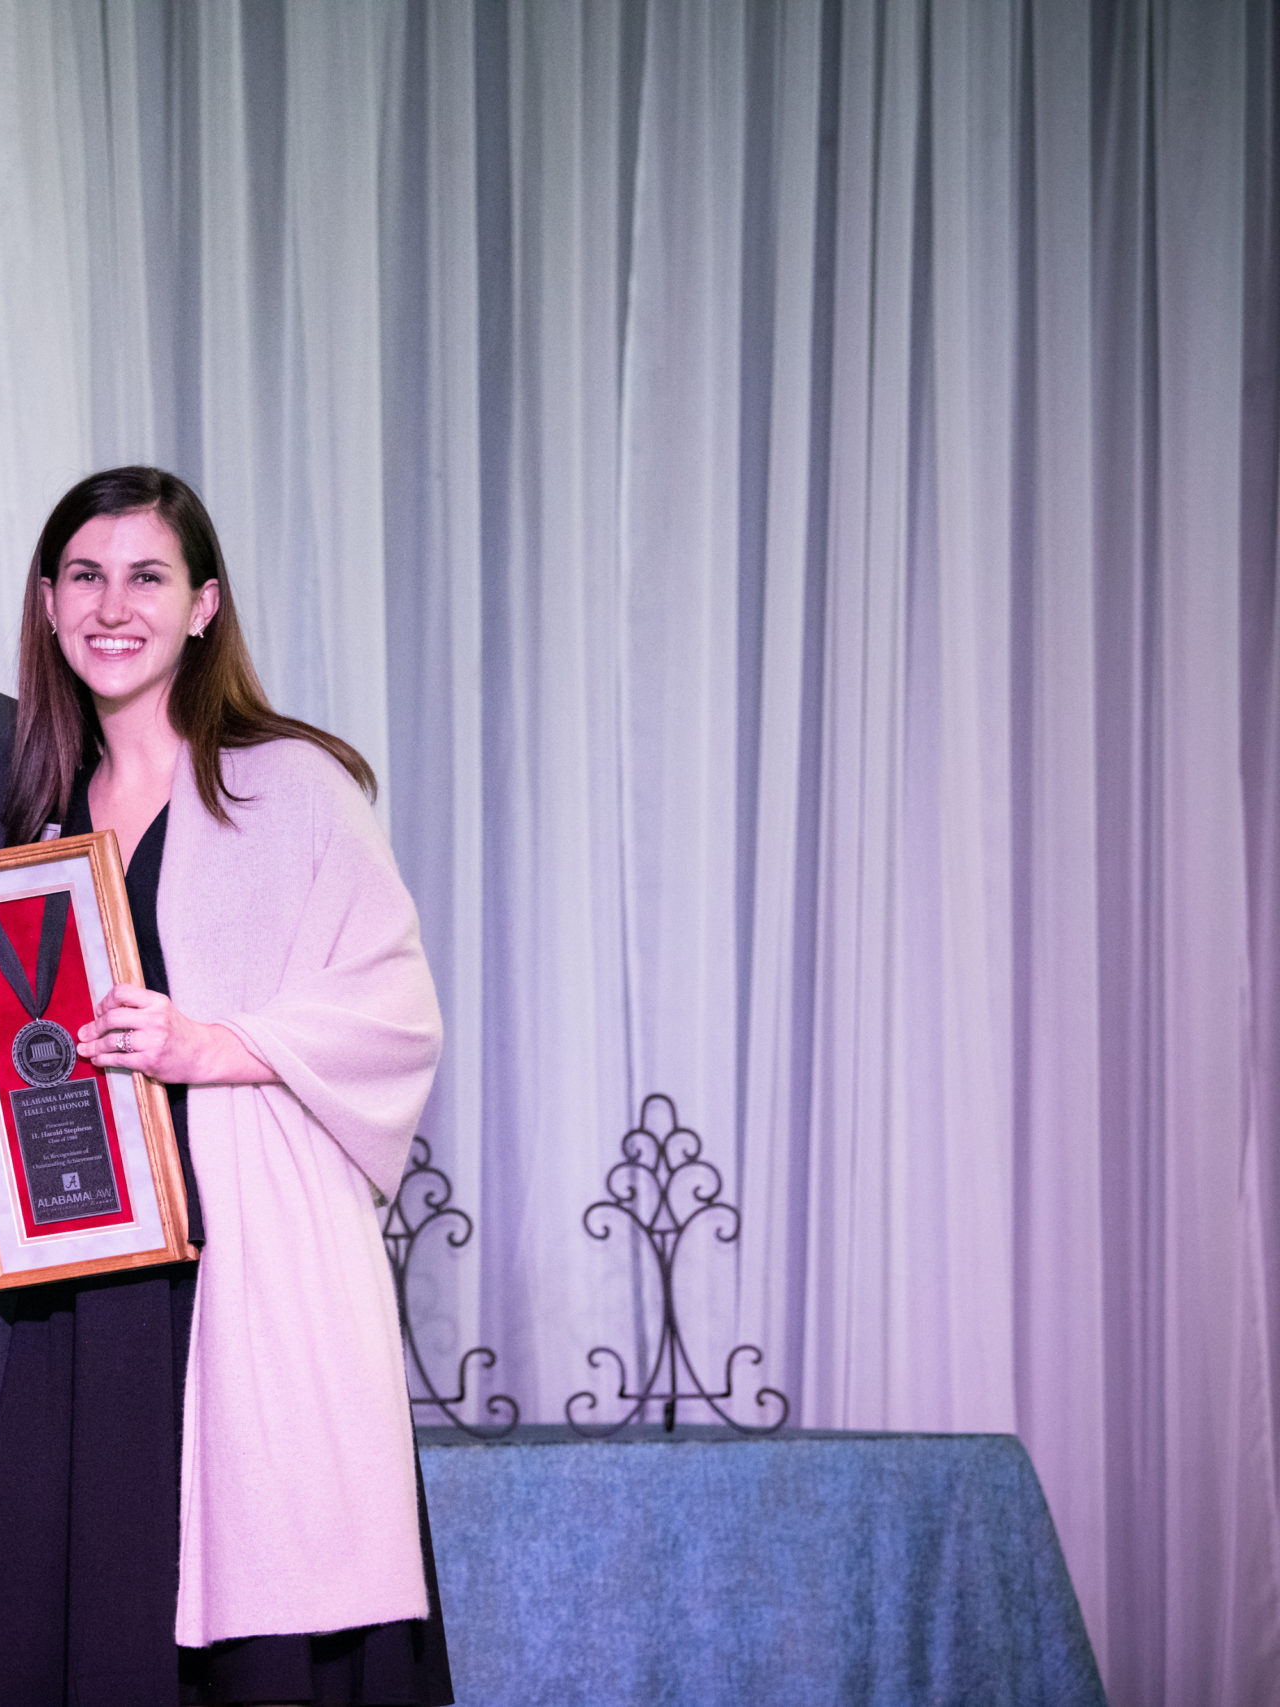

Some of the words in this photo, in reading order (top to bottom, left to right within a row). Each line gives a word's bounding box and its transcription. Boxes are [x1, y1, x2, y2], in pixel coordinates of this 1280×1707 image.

[21, 1096, 58, 1107] ALABAMA
[58, 1090, 90, 1101] LAWYER
[24, 1107, 46, 1117] HALL
[46, 1105, 58, 1113] OF
[59, 1100, 90, 1111] HONOR
[31, 1132, 40, 1140] H.
[40, 1129, 63, 1138] Harold
[64, 1125, 92, 1135] Stephens
